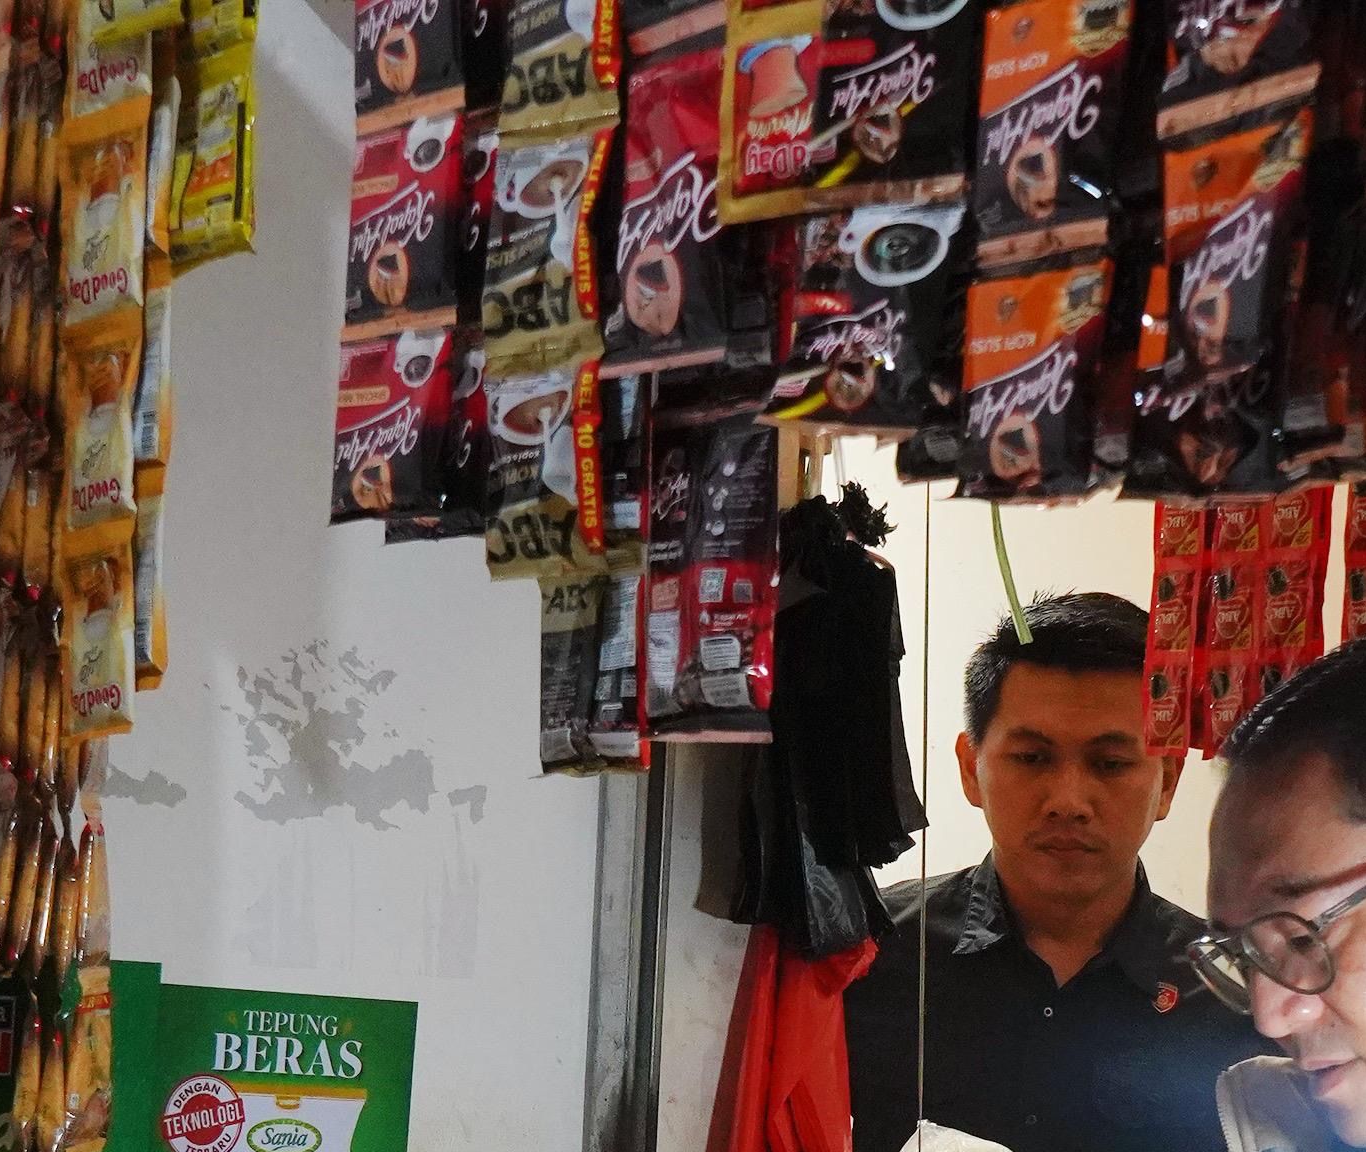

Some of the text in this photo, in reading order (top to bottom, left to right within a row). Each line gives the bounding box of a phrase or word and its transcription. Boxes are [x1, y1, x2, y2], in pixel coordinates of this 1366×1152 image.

[1026, 73, 1102, 149] Kapal
[91, 267, 129, 301] Good
[1006, 350, 1077, 425] Kapal
[369, 405, 422, 460] Kapal
[578, 422, 595, 449] 10
[580, 457, 596, 529] GRATIS
[243, 1009, 339, 1037] TEPUNG
[212, 1031, 364, 1080] BERAS
[173, 1081, 222, 1110] DENGAN
[163, 1101, 245, 1138] TEKNOLOGI
[260, 1126, 310, 1152] Sania
